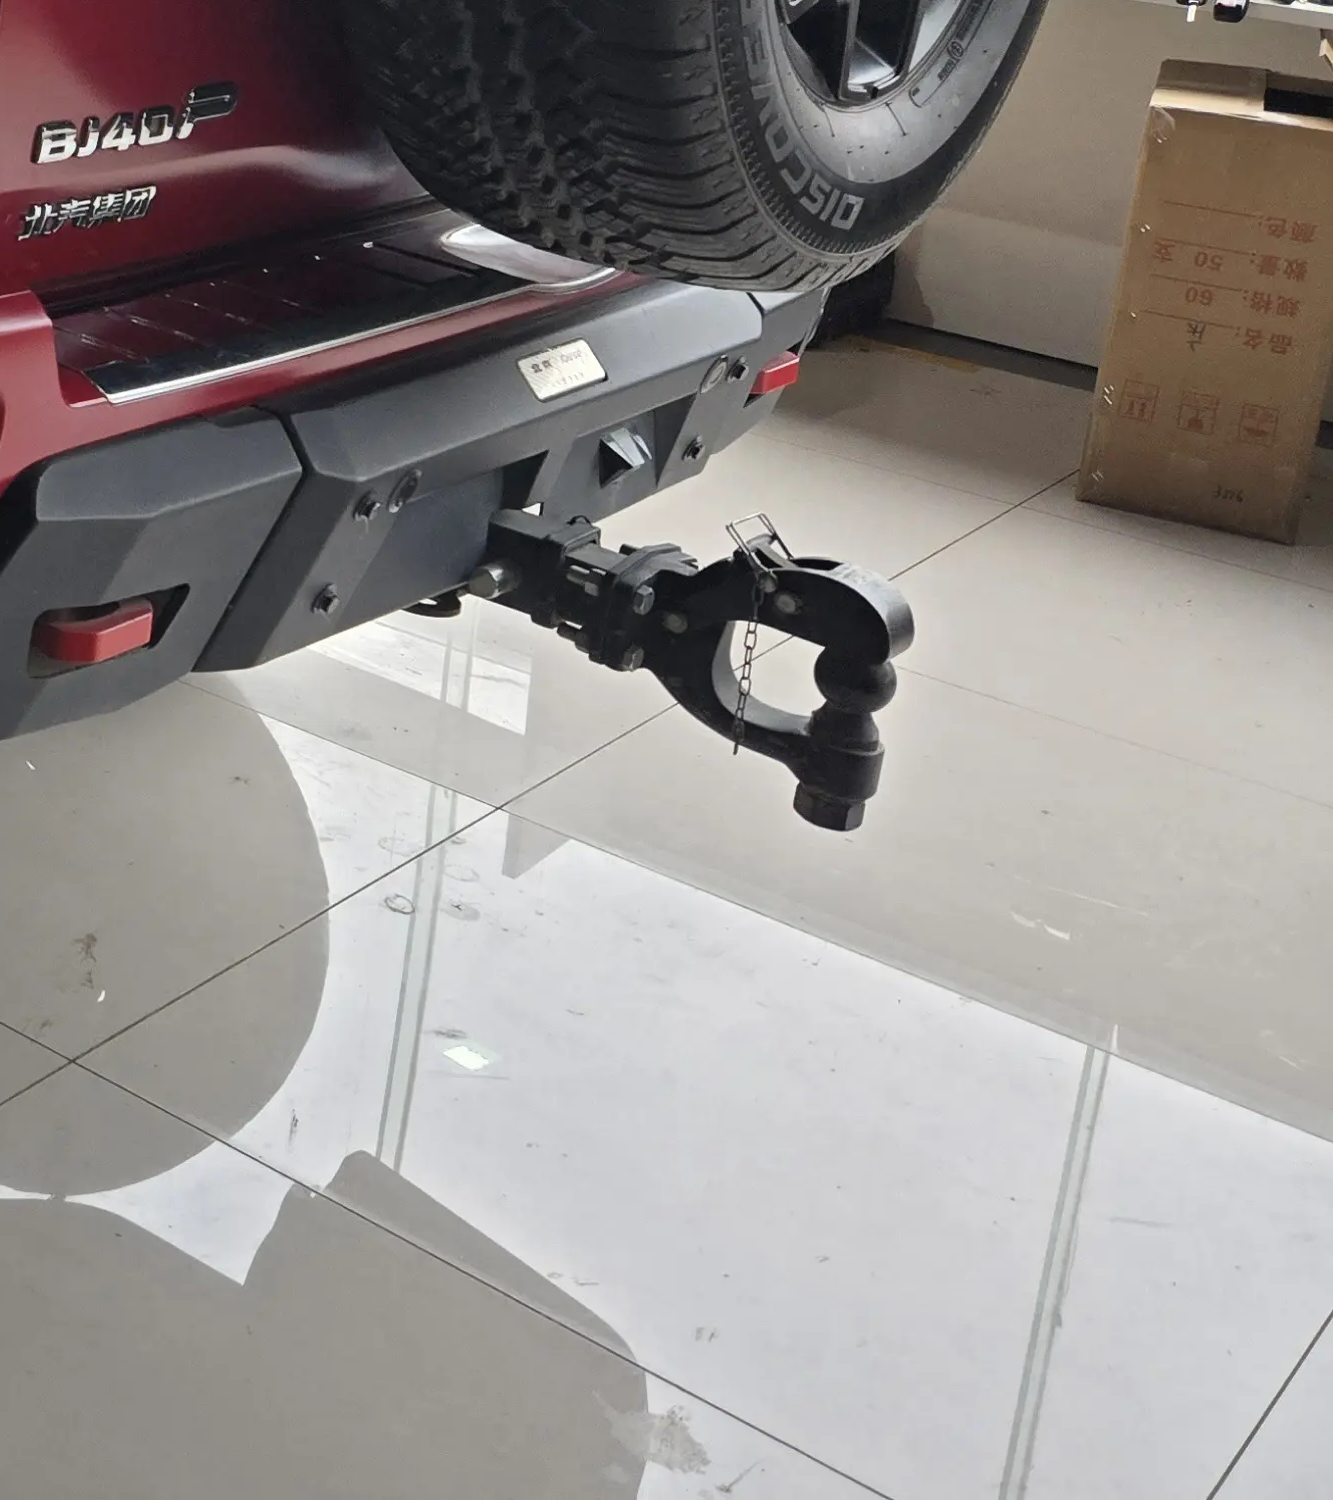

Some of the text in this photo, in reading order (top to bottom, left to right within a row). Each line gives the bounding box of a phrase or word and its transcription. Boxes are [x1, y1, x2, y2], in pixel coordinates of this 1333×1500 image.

[18, 185, 157, 241] 北汽集团
[1194, 251, 1224, 271] 50
[1185, 286, 1214, 306] 60
